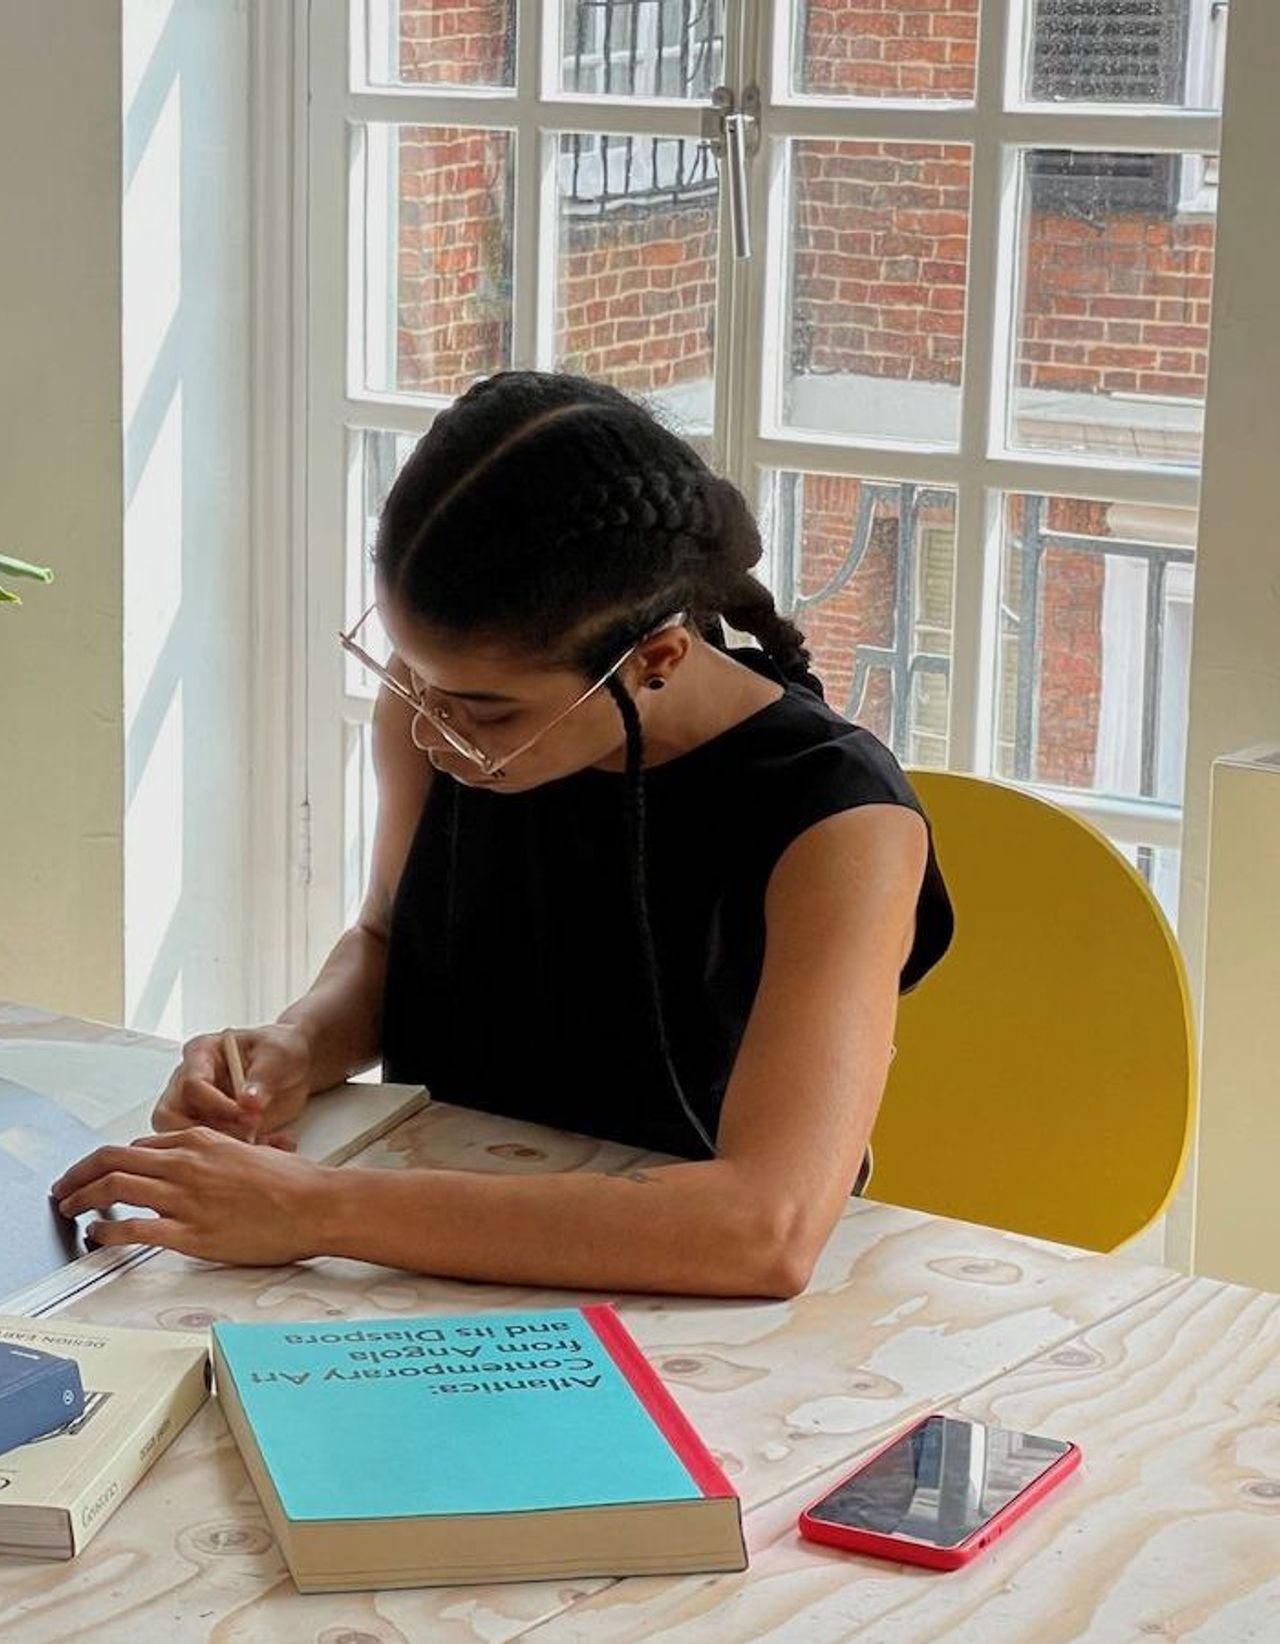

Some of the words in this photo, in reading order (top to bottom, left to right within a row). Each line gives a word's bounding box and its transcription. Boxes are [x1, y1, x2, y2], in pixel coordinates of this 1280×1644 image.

[284, 1328, 446, 1346] Diaspora
[454, 1324, 496, 1339] its
[505, 1321, 570, 1338] and
[348, 1344, 482, 1363] Angola
[495, 1339, 583, 1354] from
[323, 1357, 595, 1382] Contemporary
[251, 1371, 311, 1386] Art
[431, 1374, 603, 1396] Atlantica:
